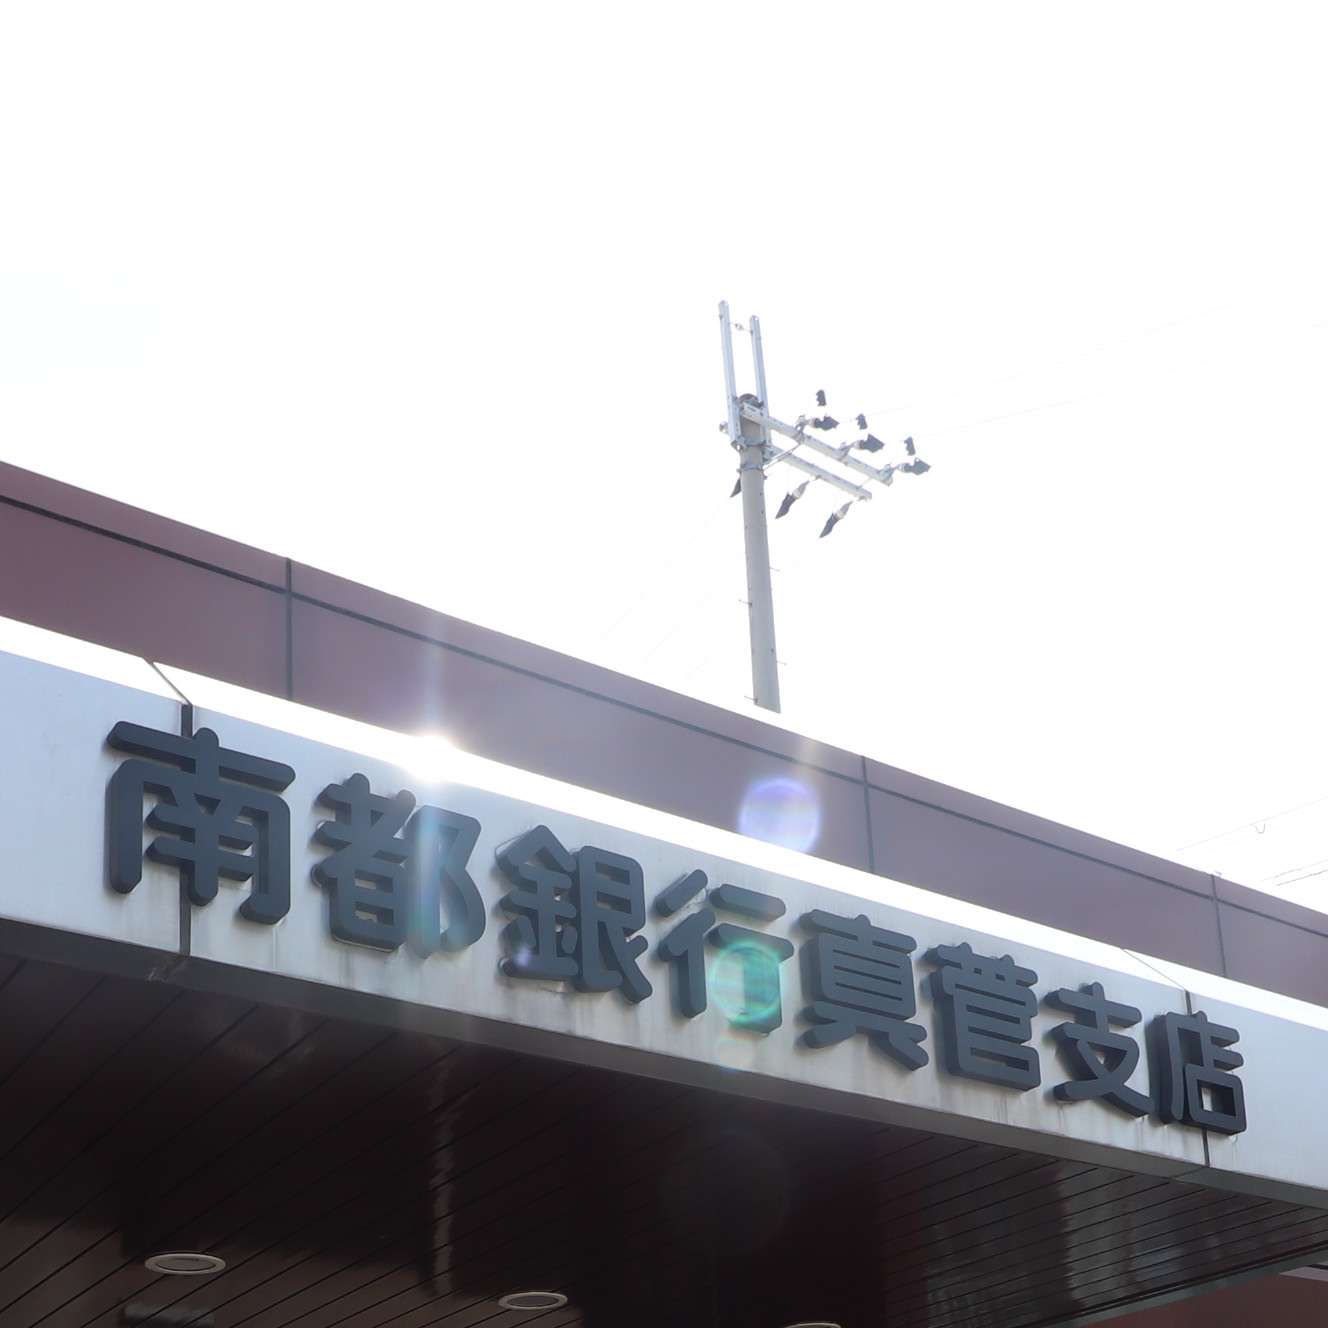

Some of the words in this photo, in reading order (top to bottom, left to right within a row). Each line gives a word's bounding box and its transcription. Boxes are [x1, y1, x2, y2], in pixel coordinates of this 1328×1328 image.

[106, 719, 1248, 1136] 南都銀行真菅支店
